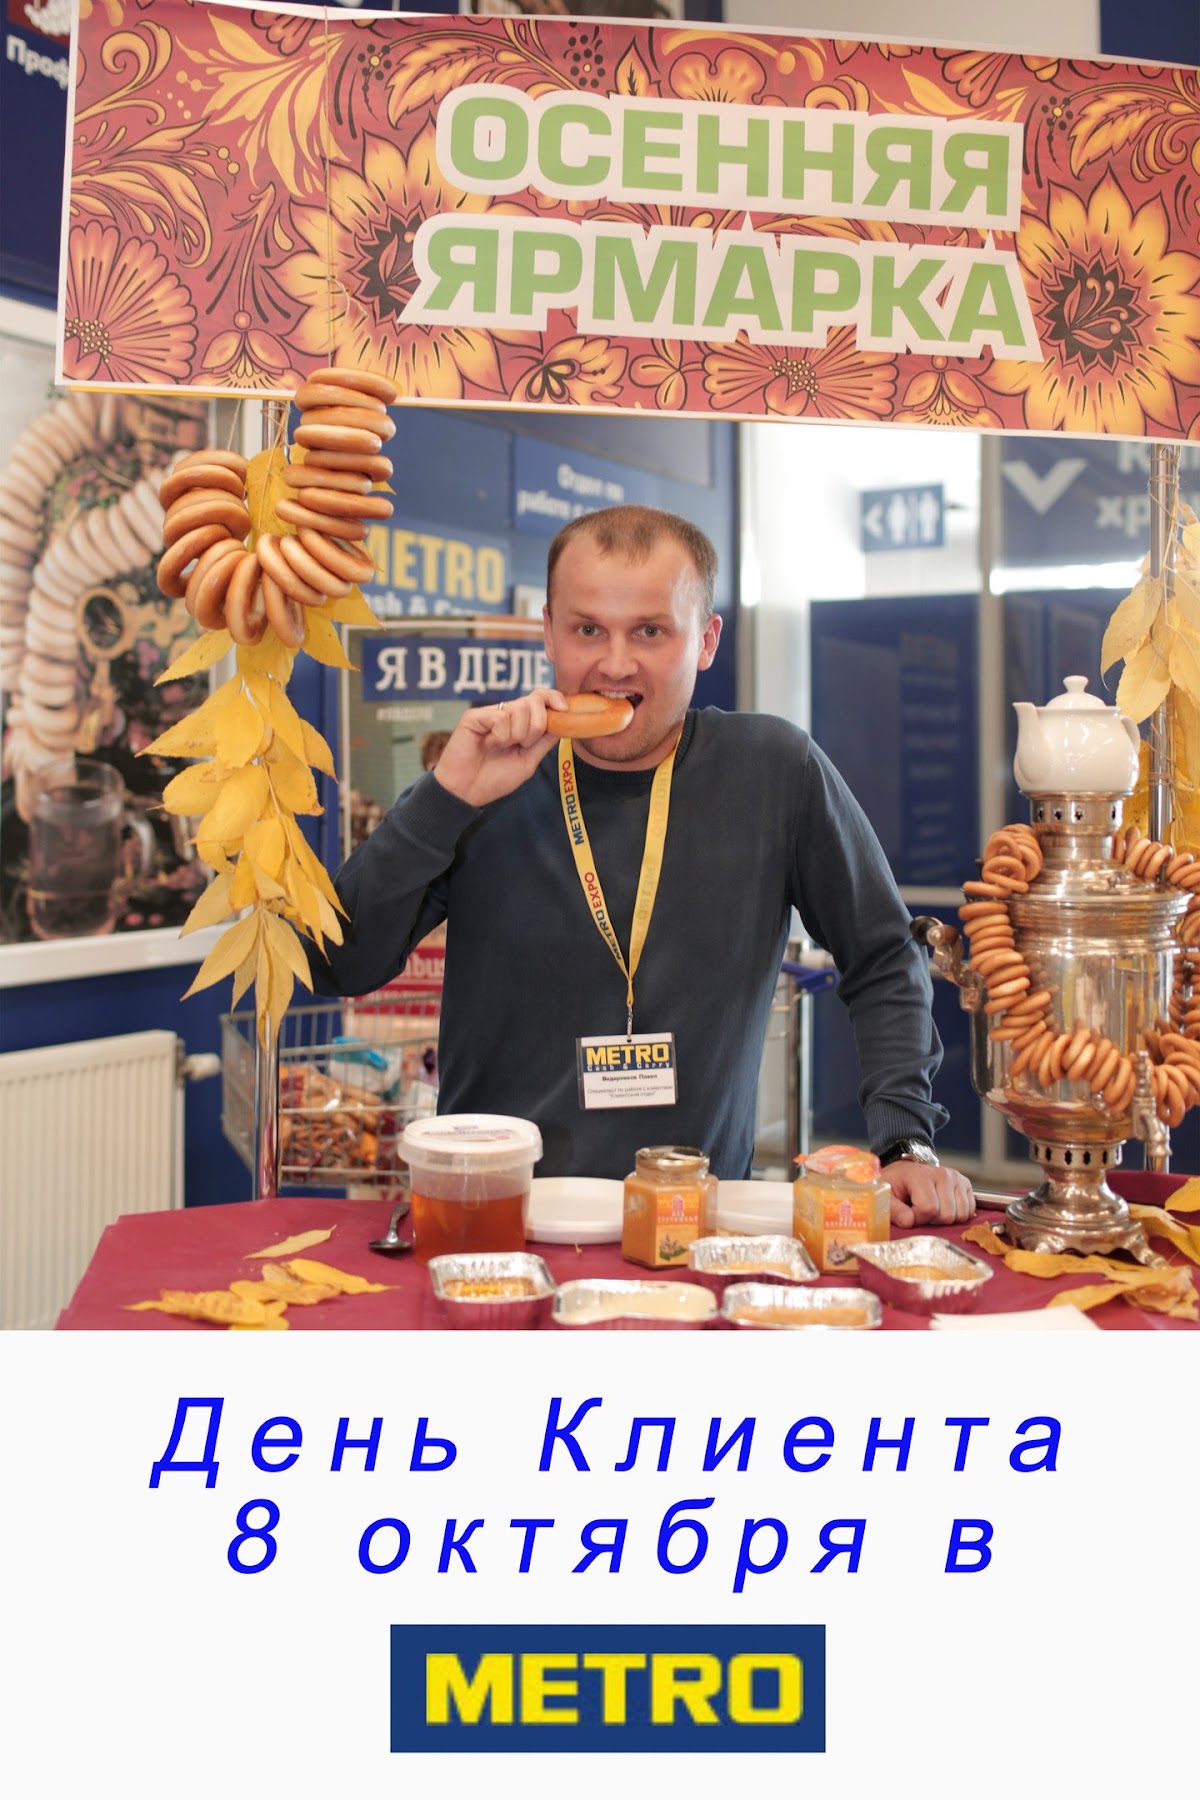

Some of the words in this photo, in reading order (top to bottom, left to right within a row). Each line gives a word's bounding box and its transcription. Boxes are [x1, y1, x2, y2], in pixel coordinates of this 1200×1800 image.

[449, 97, 1010, 217] ОСЕННЯЯ
[422, 226, 1027, 347] ЯРМАРКА
[375, 647, 408, 691] Я
[417, 647, 447, 690] В
[453, 647, 552, 694] ДЕЛЕ
[562, 760, 574, 794] EXPO
[565, 794, 585, 845] METRO
[584, 872, 602, 909] EXPO
[595, 909, 621, 960] METRO
[586, 1043, 670, 1065] METRO
[587, 1063, 615, 1072] Cash
[636, 1061, 670, 1070] Carry
